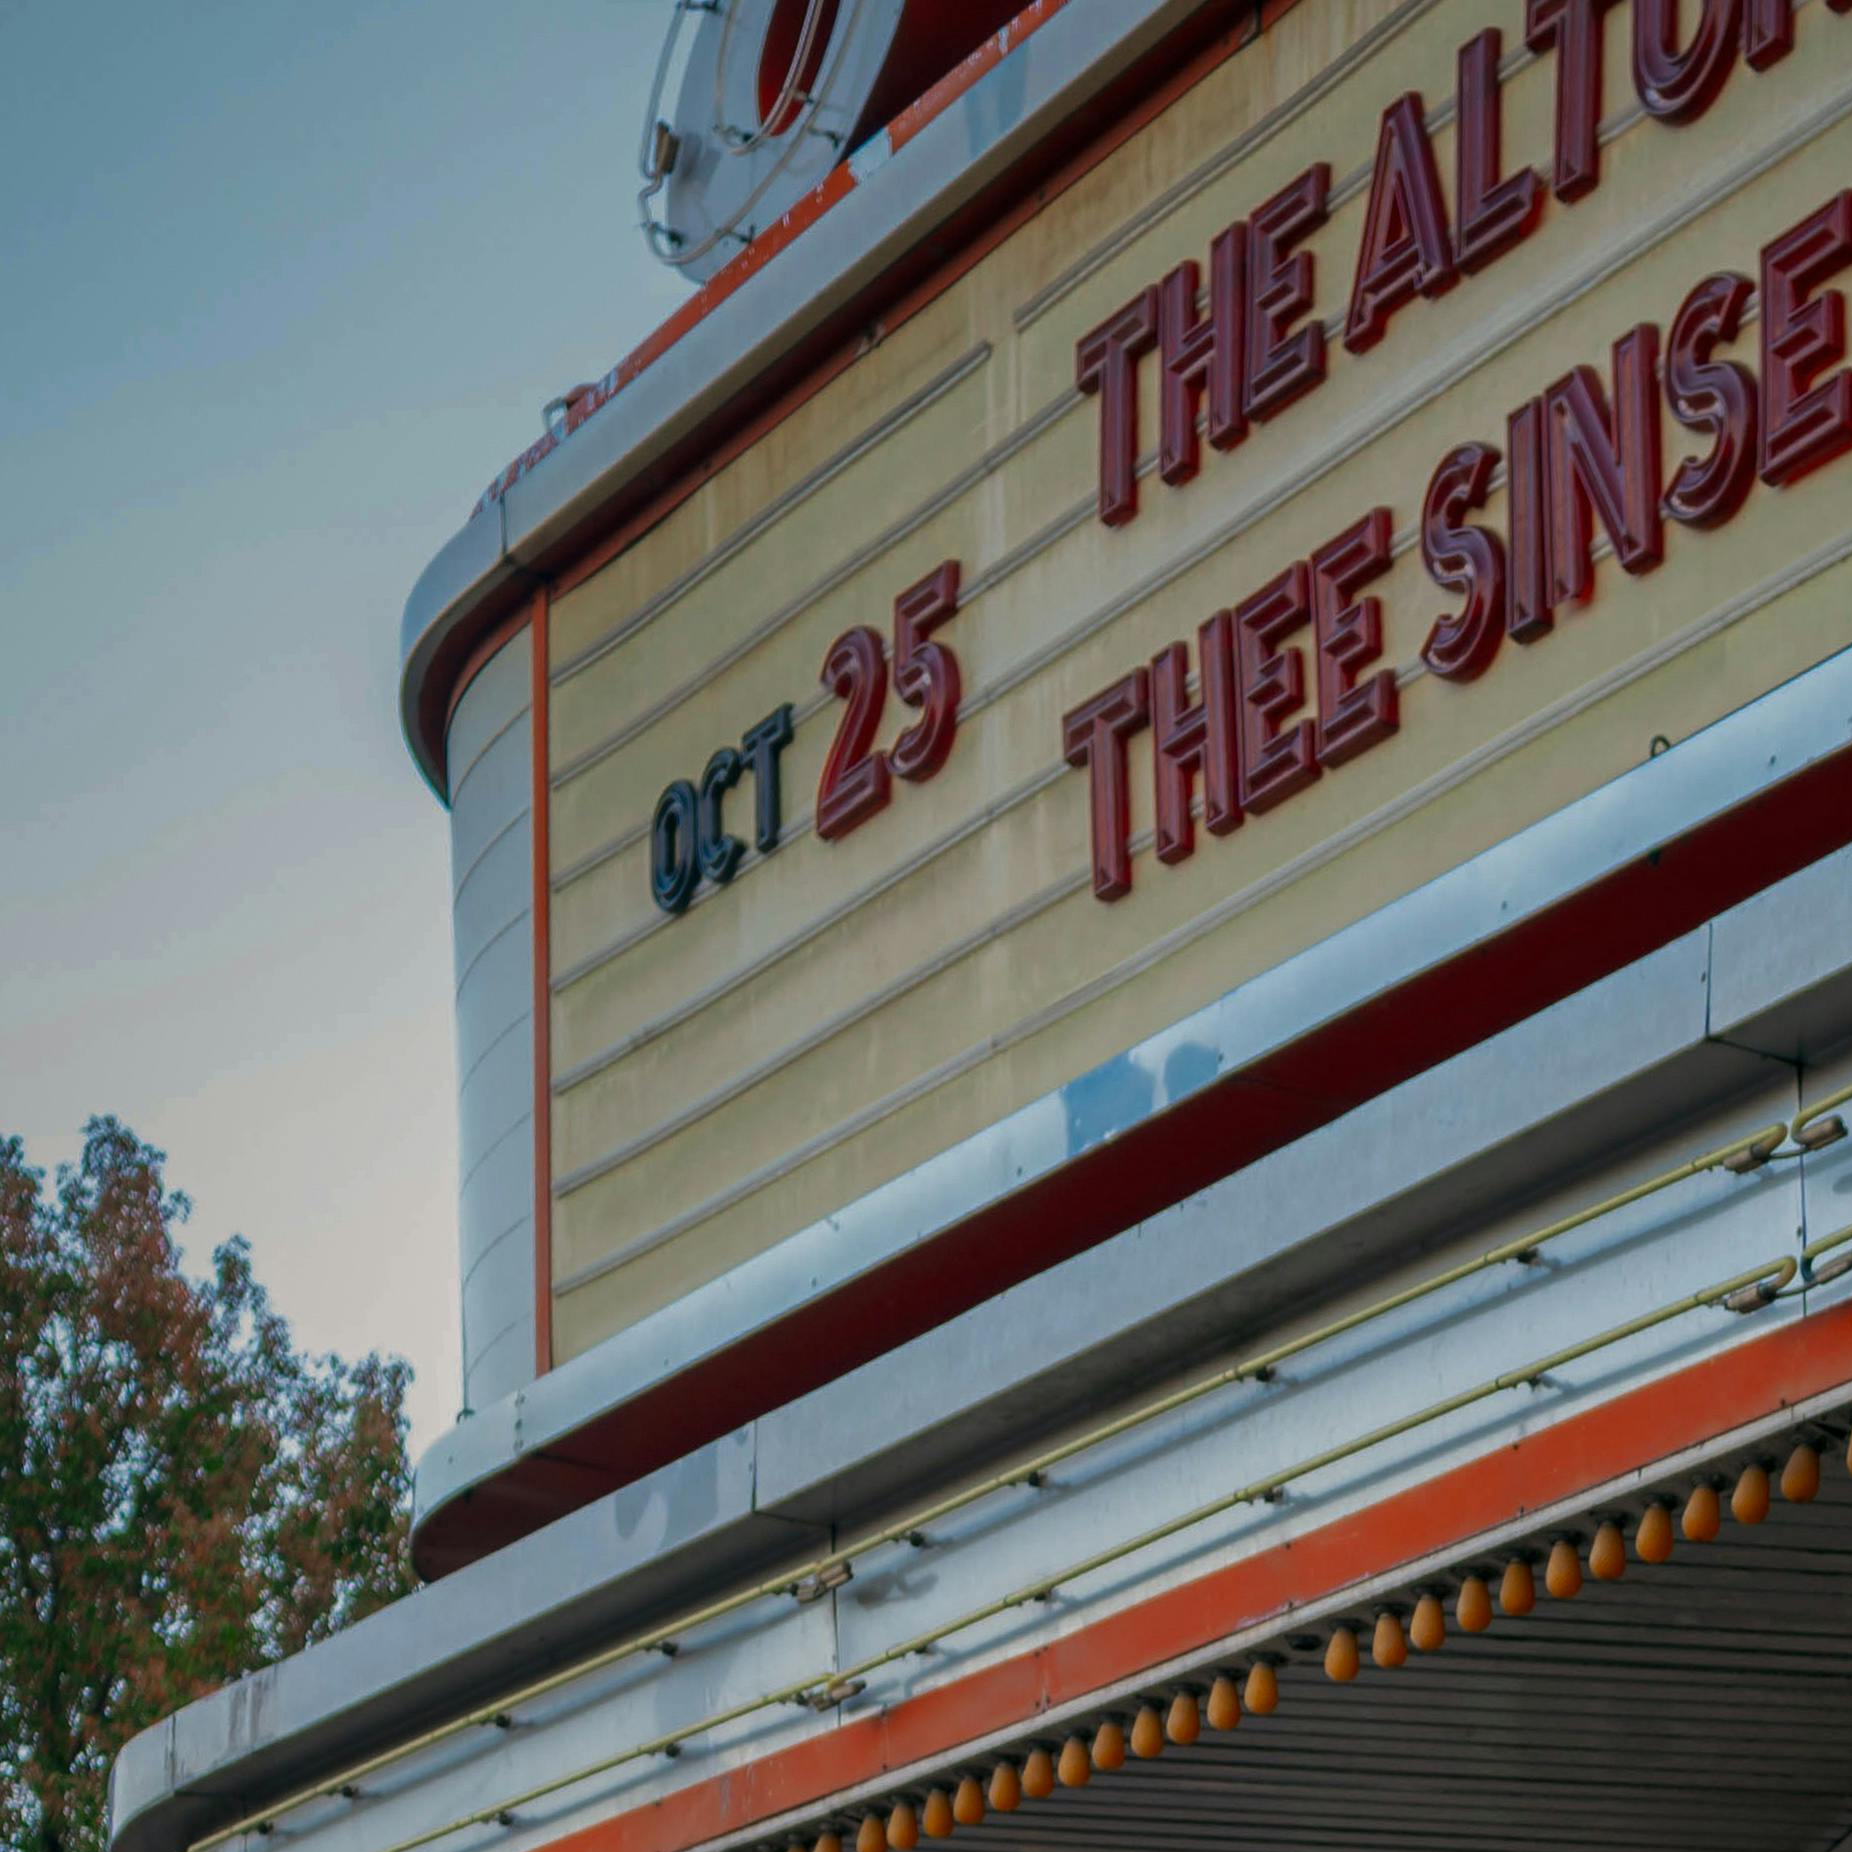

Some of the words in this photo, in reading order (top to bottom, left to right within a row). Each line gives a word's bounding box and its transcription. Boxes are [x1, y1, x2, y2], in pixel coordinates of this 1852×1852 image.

[1076, 161, 1334, 527] THE
[650, 701, 795, 915] OCT
[816, 559, 960, 841] 25
[1062, 506, 1400, 902] THEE
